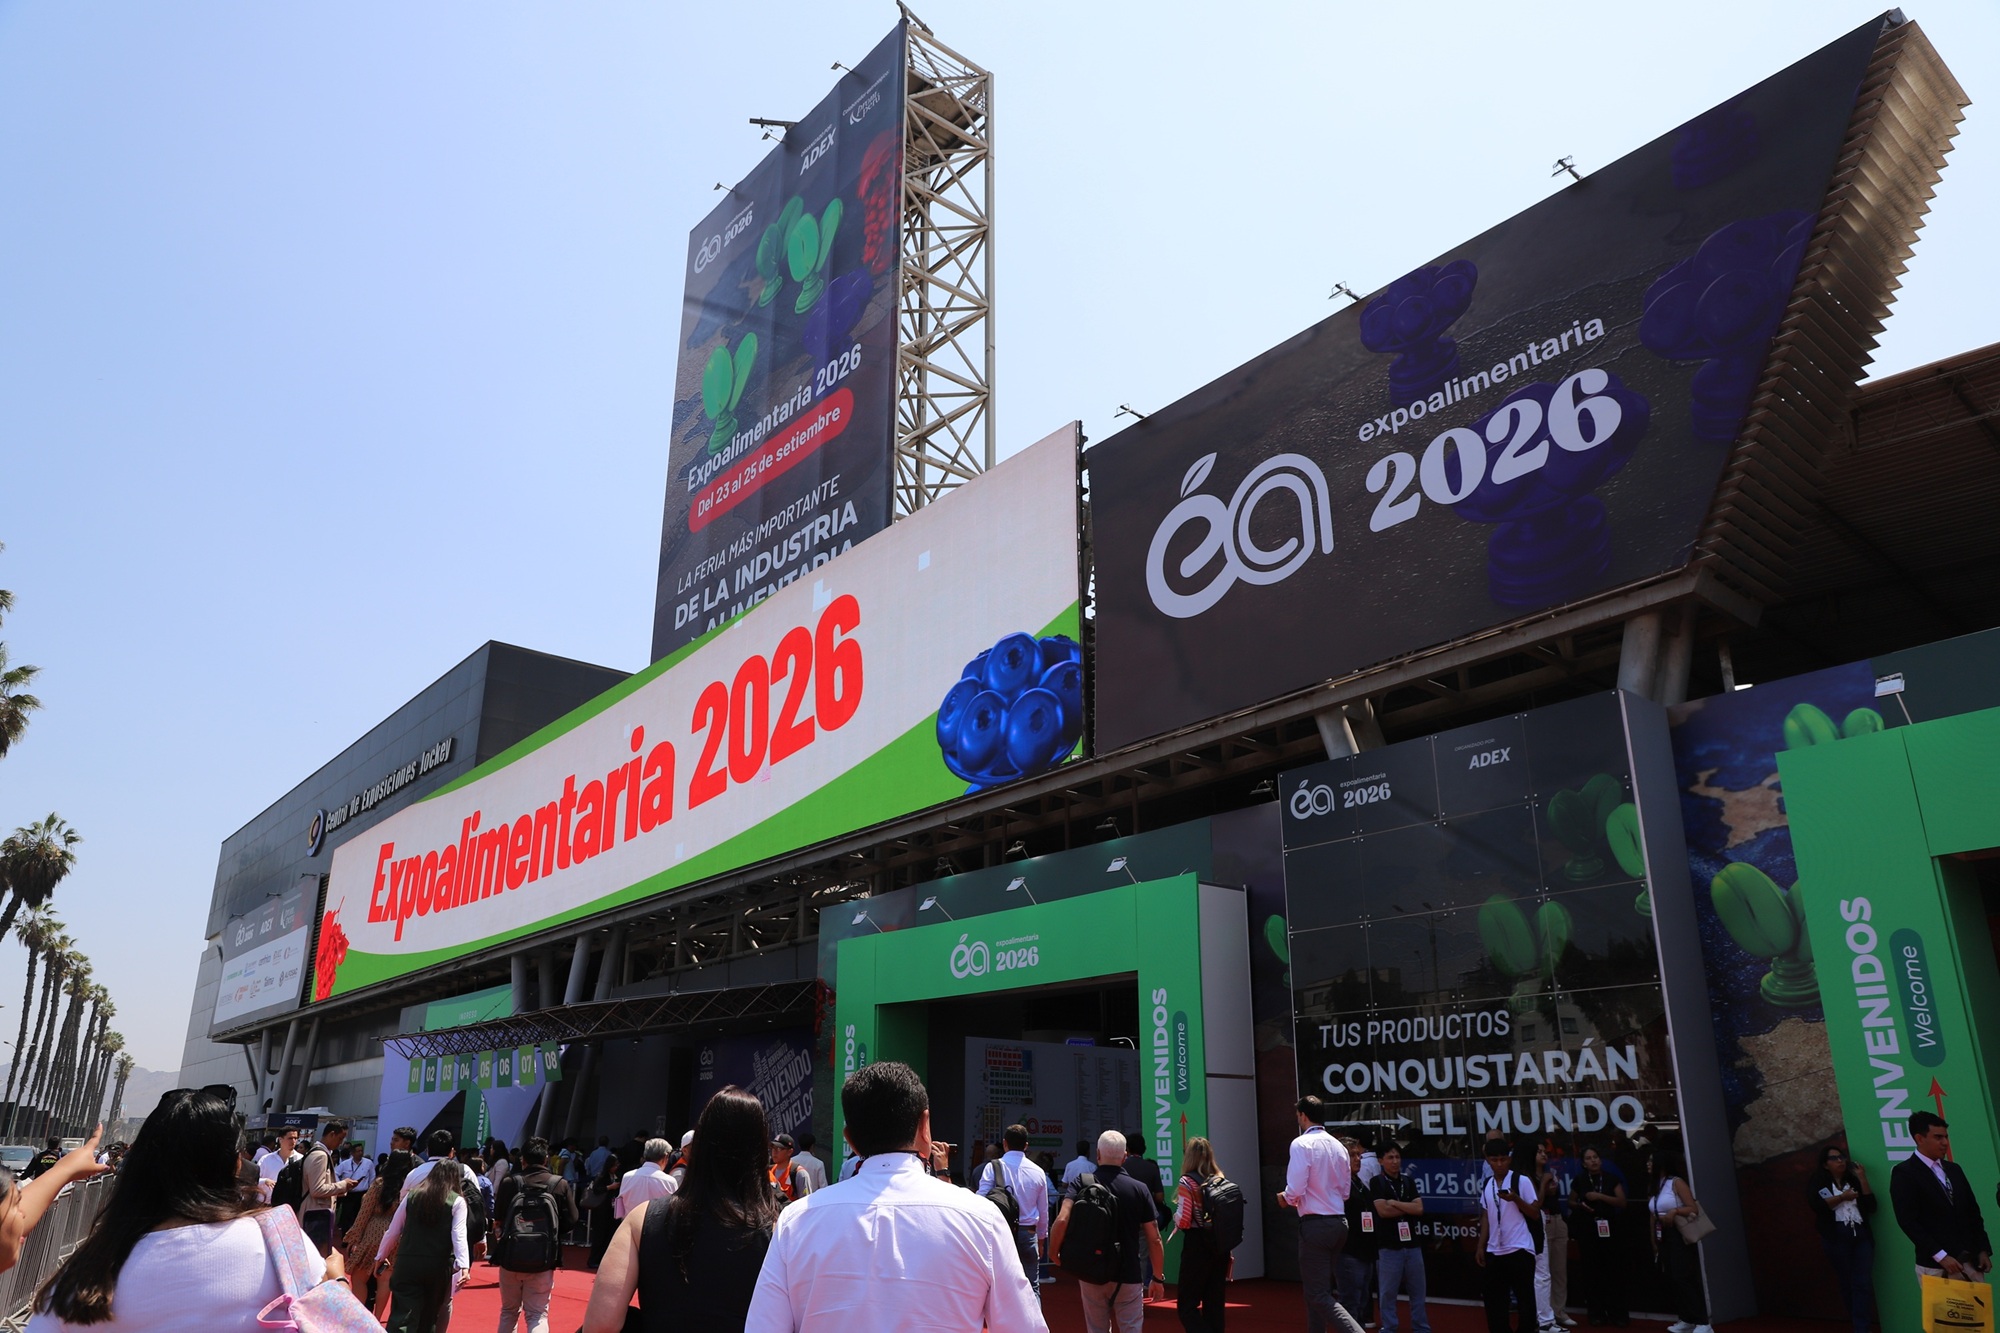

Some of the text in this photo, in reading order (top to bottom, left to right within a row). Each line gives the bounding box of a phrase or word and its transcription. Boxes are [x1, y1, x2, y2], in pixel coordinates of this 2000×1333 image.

[800, 127, 836, 176] ADEX
[724, 210, 753, 248] 2026
[1359, 318, 1605, 442] expoalimentaria
[688, 343, 862, 491] Expoalimentaria 2026
[698, 406, 841, 518] Del 23 al 25 de setiembre
[1366, 368, 1623, 532] 2026
[677, 474, 841, 595] LA FERIA MÁS IMPORTANTE
[674, 500, 859, 631] DE LA INDUSTRIA
[367, 594, 864, 942] Expoalimentaria 2026
[1469, 747, 1511, 770] ADEX
[325, 738, 452, 832] Centro de Exposiciones Jockey
[1340, 772, 1387, 788] expoalimentaria
[1343, 782, 1392, 808] 2026
[996, 933, 1039, 947] expoalimentaria
[996, 946, 1039, 972] 2026
[1902, 945, 1937, 1048] Welcome
[1319, 1009, 1510, 1048] TUS PRODUCTOS
[1840, 896, 1914, 1167] IENVENIDOS
[411, 1067, 419, 1083] 01
[426, 1066, 435, 1082] 02
[443, 1064, 451, 1080] 03
[460, 1063, 469, 1080] 04
[480, 1061, 490, 1077] 05
[499, 1058, 509, 1076] 06
[521, 1055, 532, 1073] 07
[545, 1051, 557, 1070] 08
[1178, 1022, 1187, 1091] Welcome
[1322, 1037, 1639, 1098] CONQUISTARÁN
[1152, 987, 1173, 1187] BIENVENIDOS
[1042, 1125, 1063, 1134] 2026
[1420, 1095, 1645, 1135] EL MUNDO
[1415, 1173, 1430, 1194] al
[1434, 1173, 1457, 1195] 25
[1415, 1221, 1430, 1236] de
